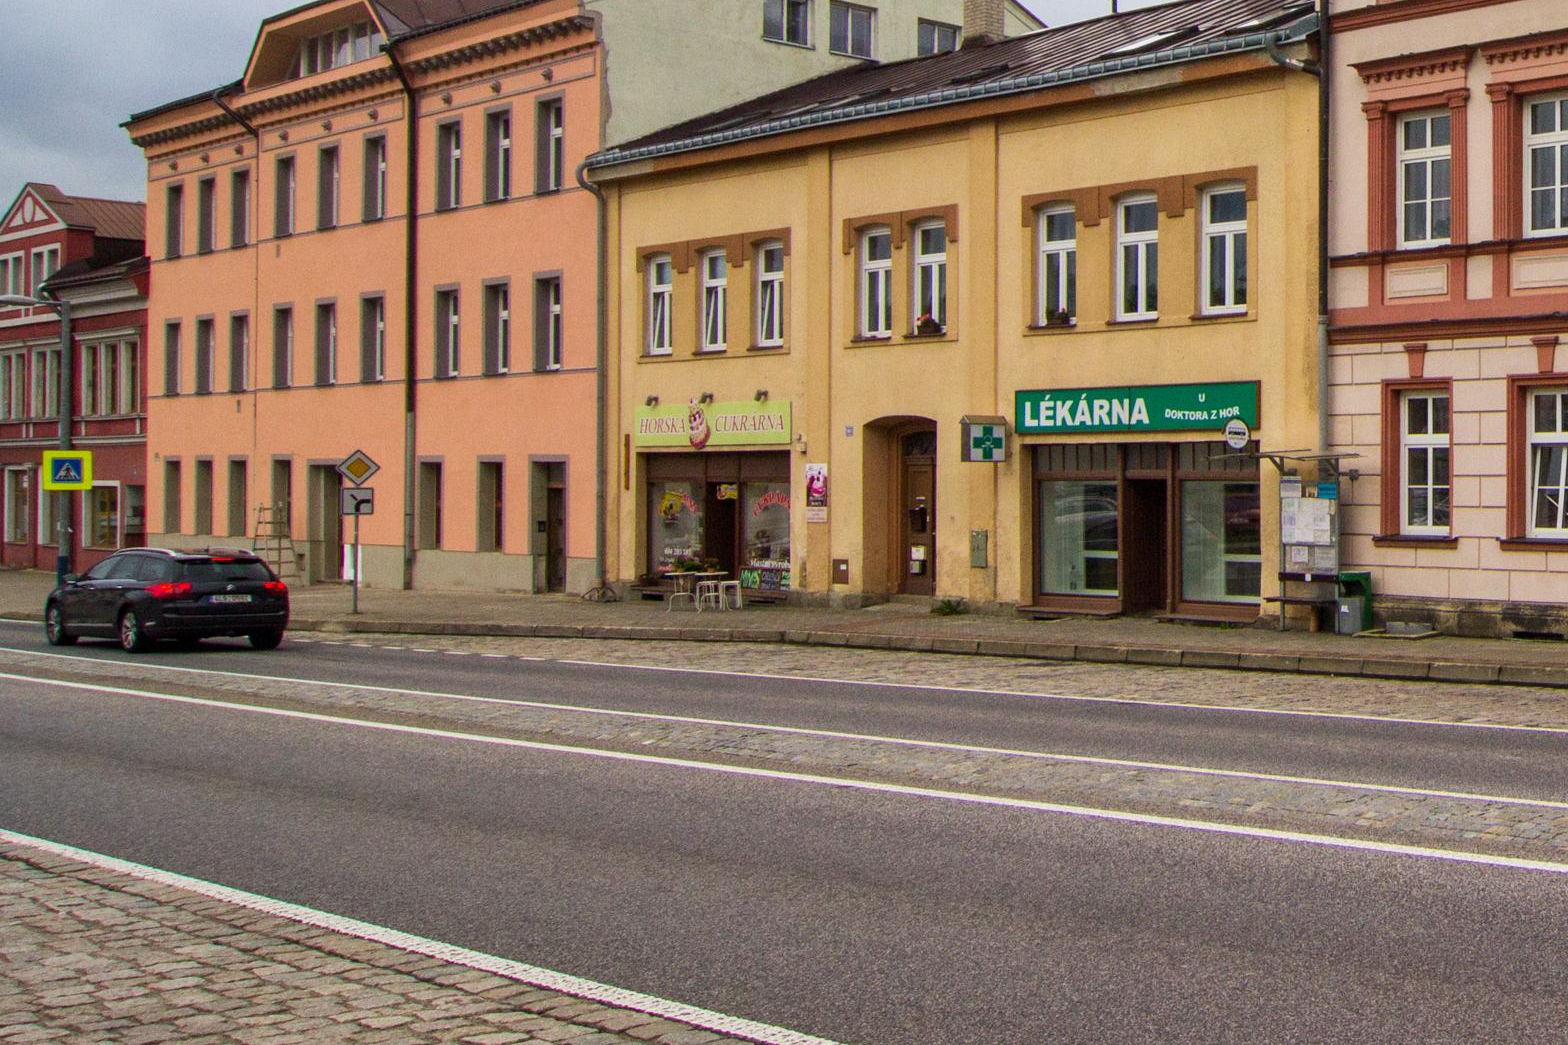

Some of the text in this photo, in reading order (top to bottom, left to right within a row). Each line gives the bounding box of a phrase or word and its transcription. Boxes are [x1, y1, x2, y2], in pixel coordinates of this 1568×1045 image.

[1198, 392, 1206, 403] U
[1024, 393, 1150, 427] LÉKÁRNA
[1164, 406, 1240, 420] DOKTORA Z HOR
[715, 411, 785, 432] CUKRÁRNA
